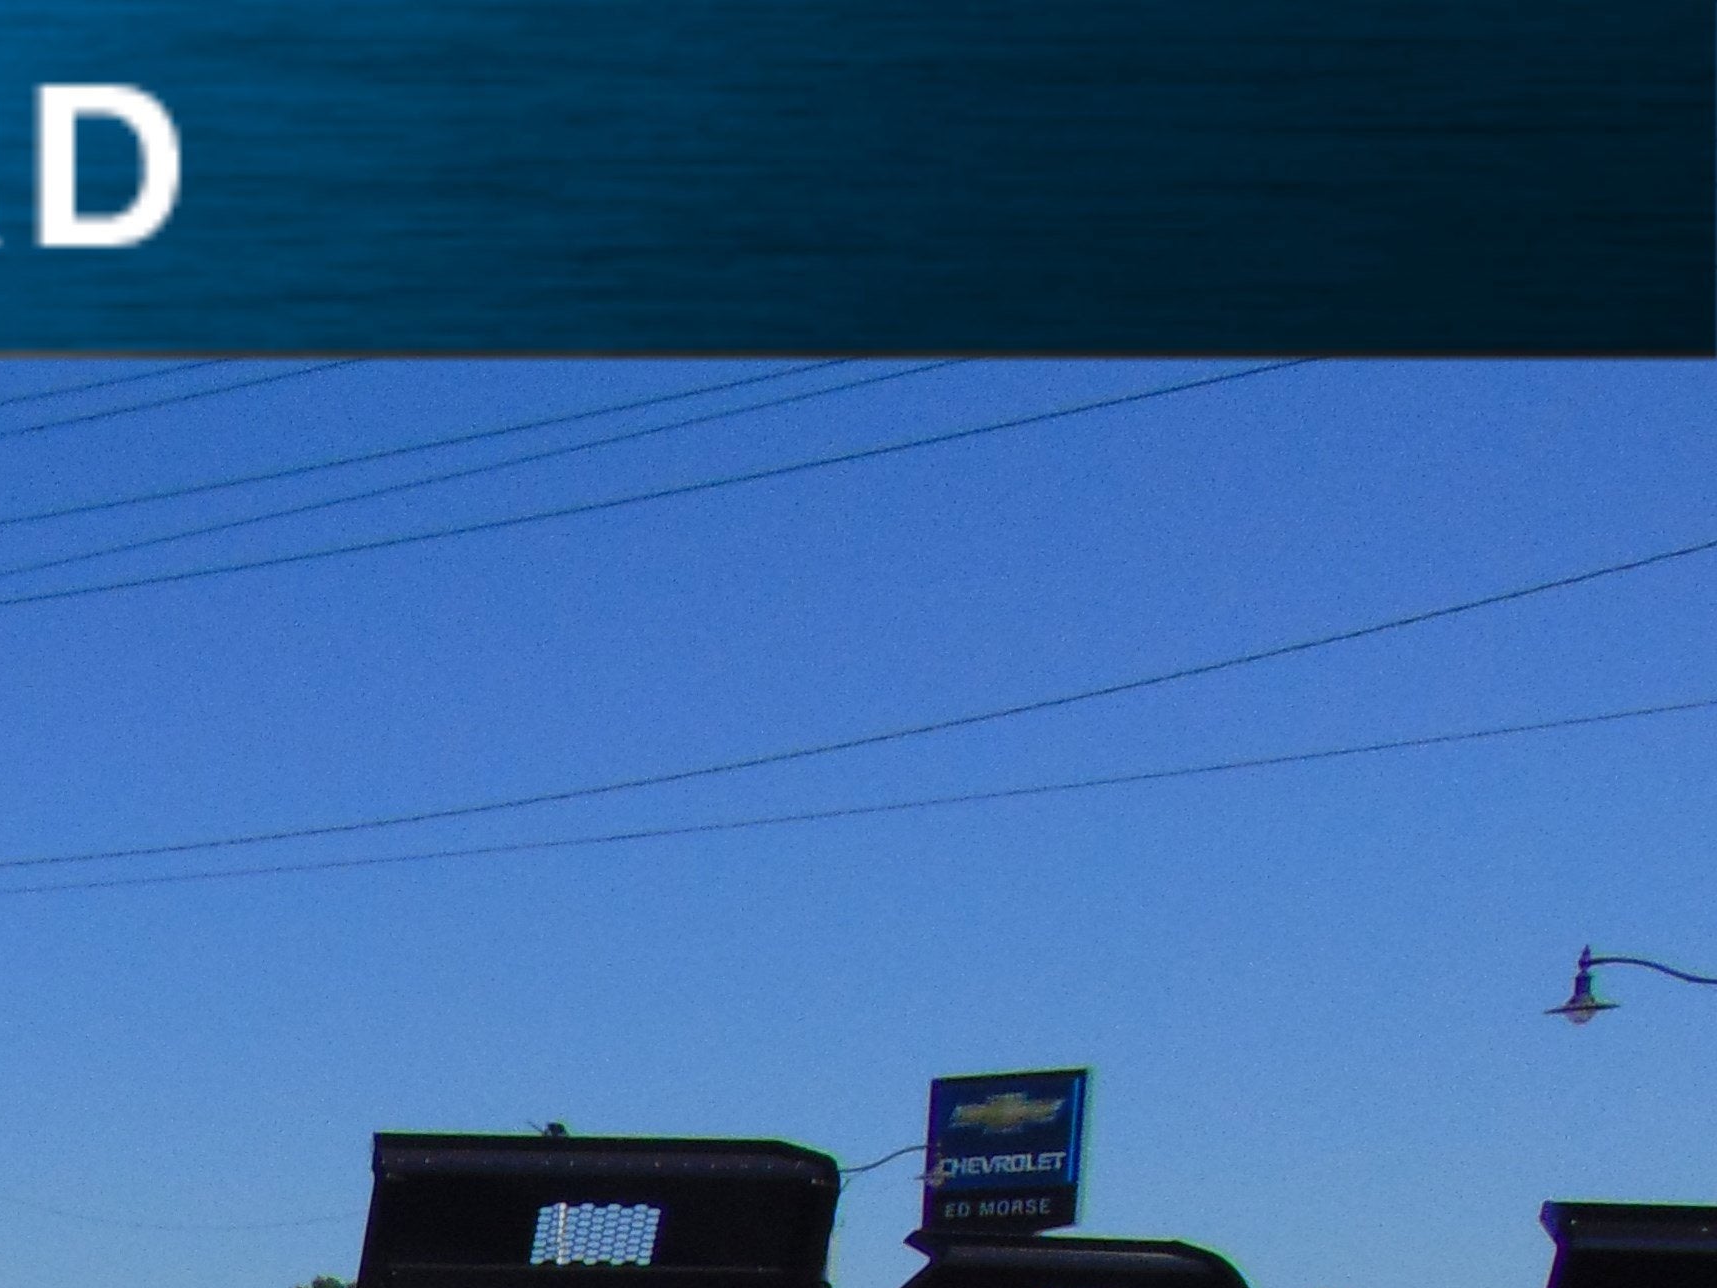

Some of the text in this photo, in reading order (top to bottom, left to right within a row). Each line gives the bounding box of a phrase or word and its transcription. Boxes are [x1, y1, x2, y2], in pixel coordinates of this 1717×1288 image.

[940, 1151, 1067, 1179] CHEVROLET
[944, 1198, 1052, 1219] ED MORSE
